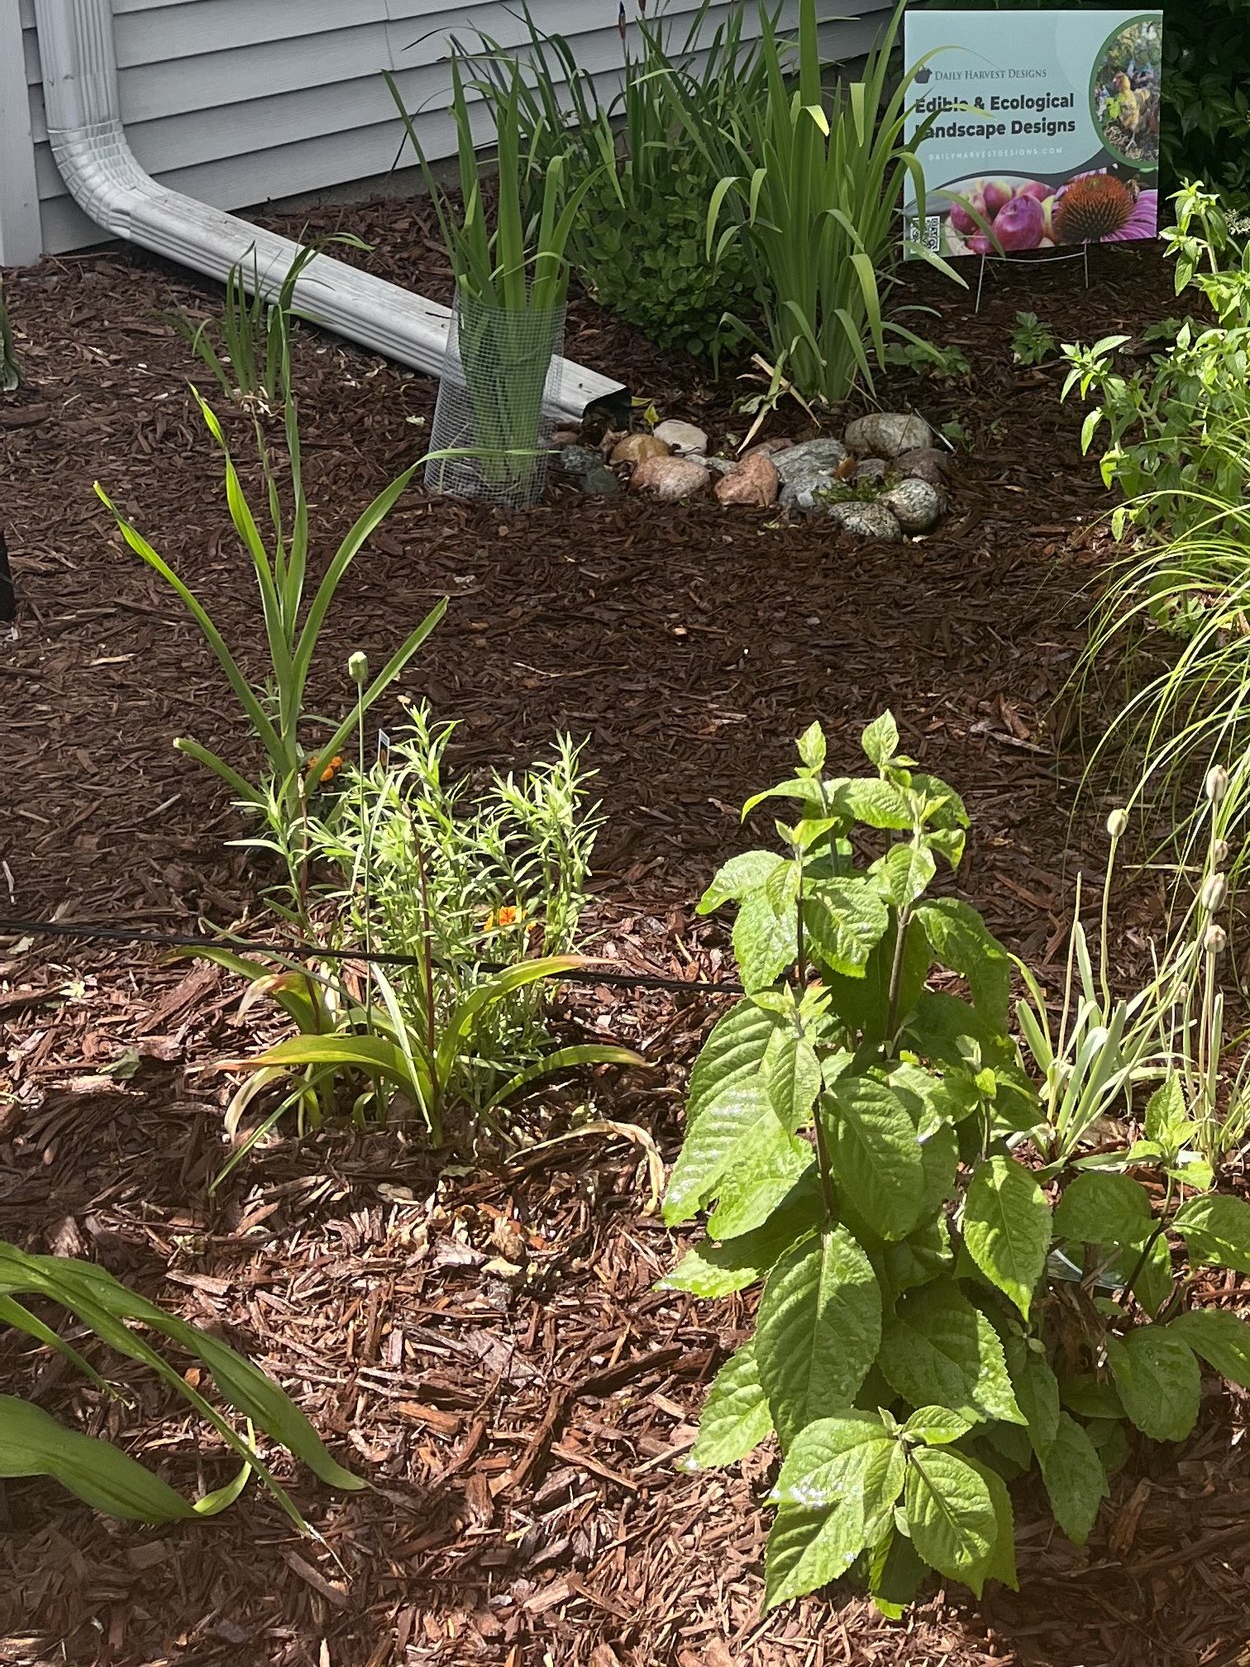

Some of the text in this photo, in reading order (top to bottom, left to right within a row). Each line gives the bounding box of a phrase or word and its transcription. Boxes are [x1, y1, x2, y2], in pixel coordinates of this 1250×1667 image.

[935, 68, 1047, 81] DAILY HARVEST DESIGNS
[974, 96, 985, 111] &
[990, 92, 1074, 112] Ecological
[1011, 117, 1076, 136] Designs
